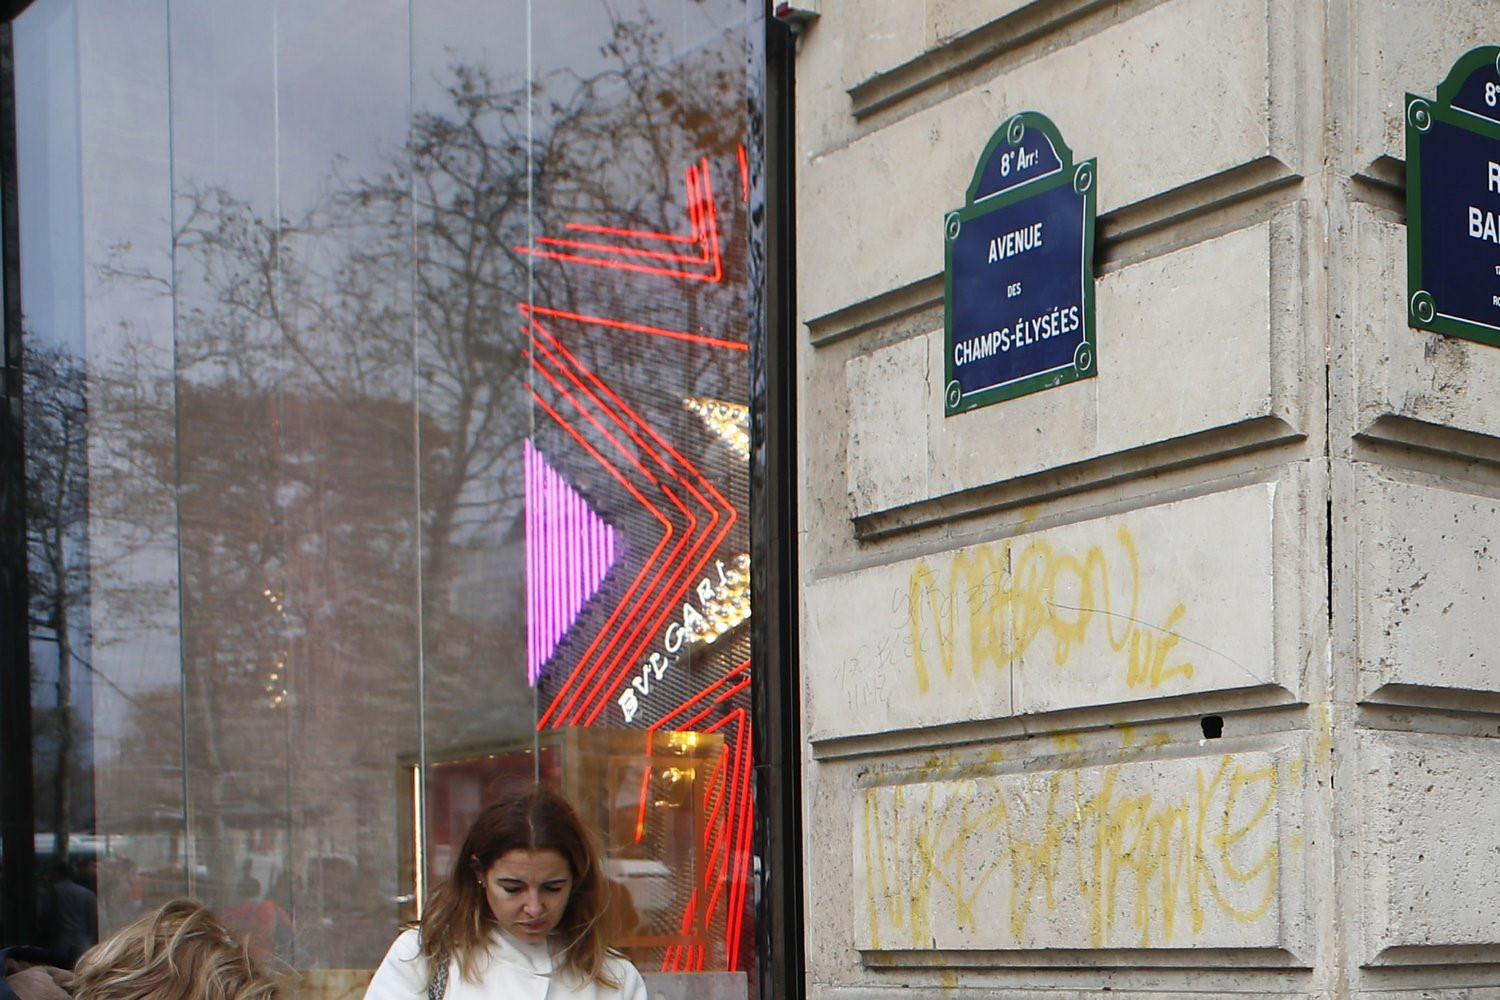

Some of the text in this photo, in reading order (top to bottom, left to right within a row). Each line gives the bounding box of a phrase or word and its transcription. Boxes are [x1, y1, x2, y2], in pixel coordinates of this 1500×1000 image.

[988, 222, 1042, 264] AVENUE
[1007, 282, 1022, 299] DES
[954, 305, 1080, 367] CHAMPS-ÉLYSÉES
